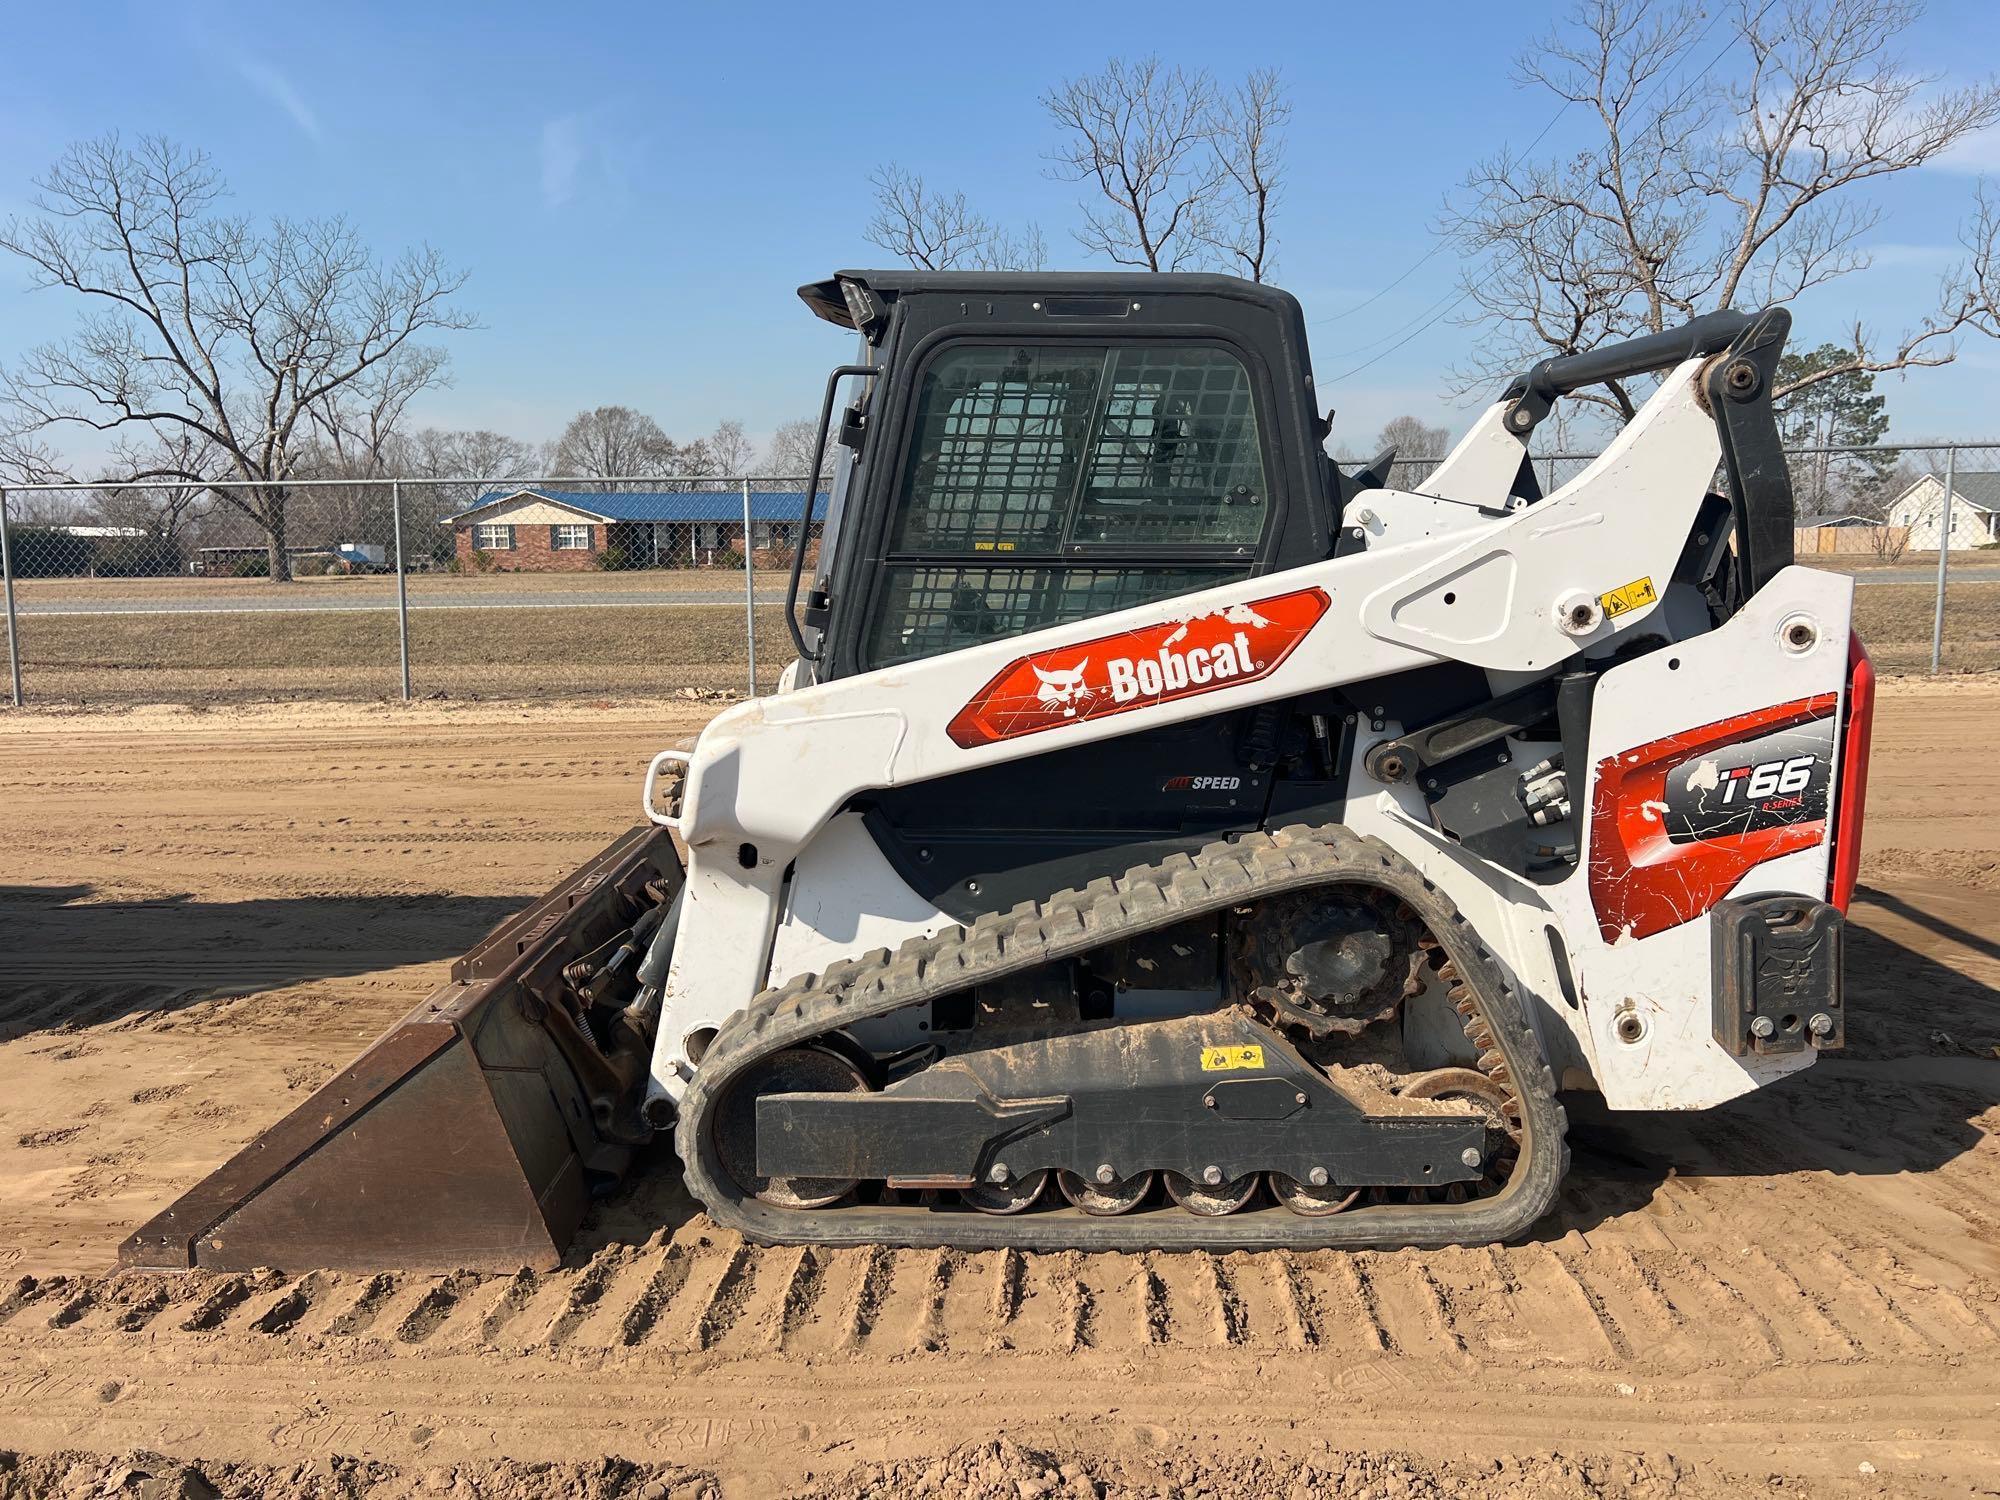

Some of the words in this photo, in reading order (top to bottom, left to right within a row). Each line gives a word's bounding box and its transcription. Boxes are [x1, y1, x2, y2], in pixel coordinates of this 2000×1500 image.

[1107, 632, 1254, 703] Bobcat
[1192, 776, 1240, 790] SPEED
[1720, 756, 1815, 804] T66
